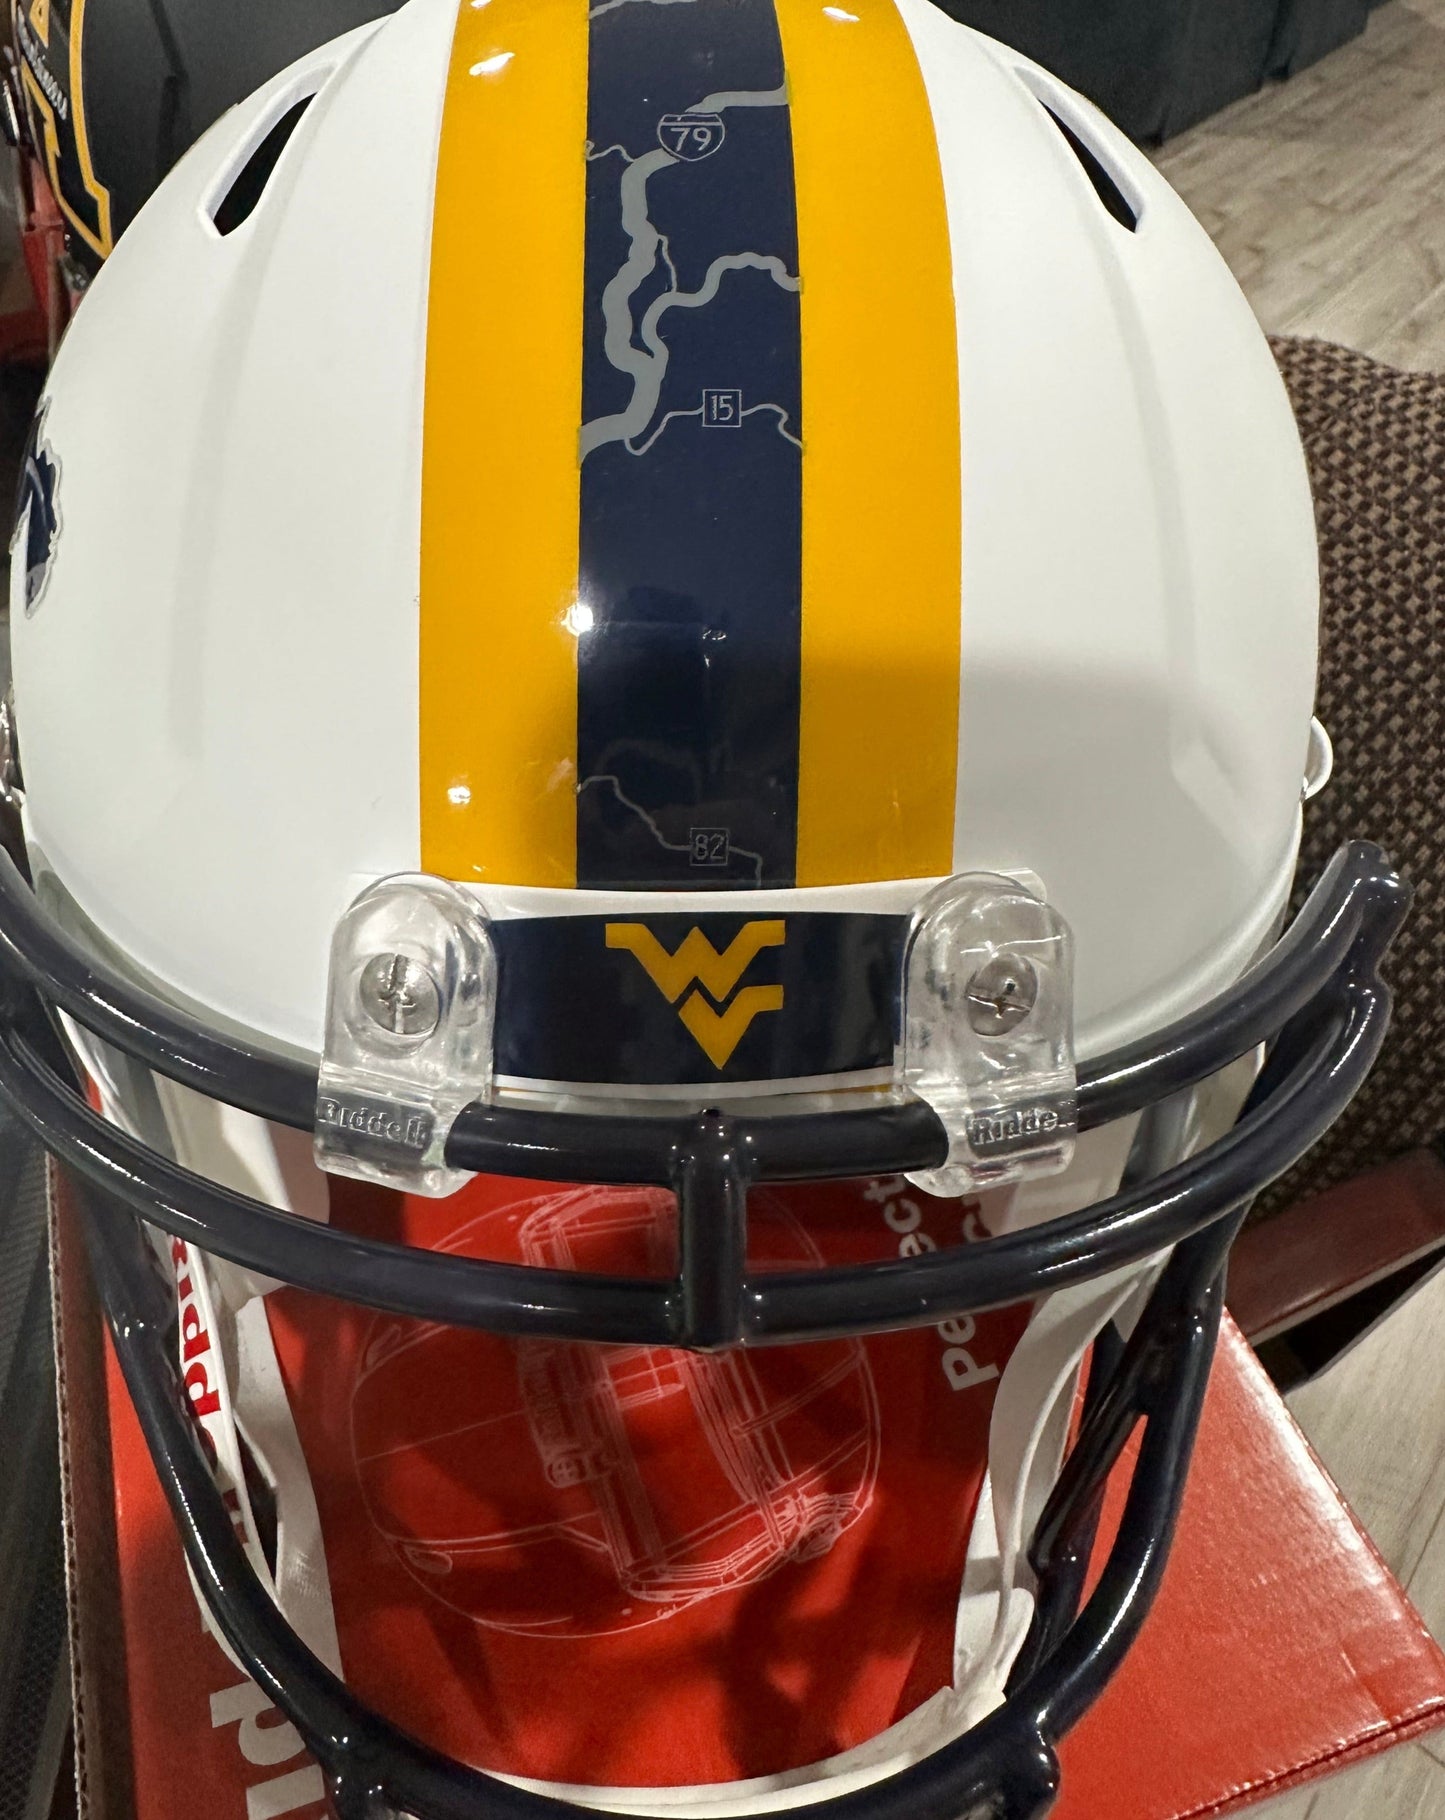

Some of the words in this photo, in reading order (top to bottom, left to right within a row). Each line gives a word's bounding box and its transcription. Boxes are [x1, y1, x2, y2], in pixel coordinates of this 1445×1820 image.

[670, 127, 712, 152] 79
[711, 394, 734, 421] 15
[695, 833, 725, 860] 82
[317, 1096, 429, 1149] Riddell
